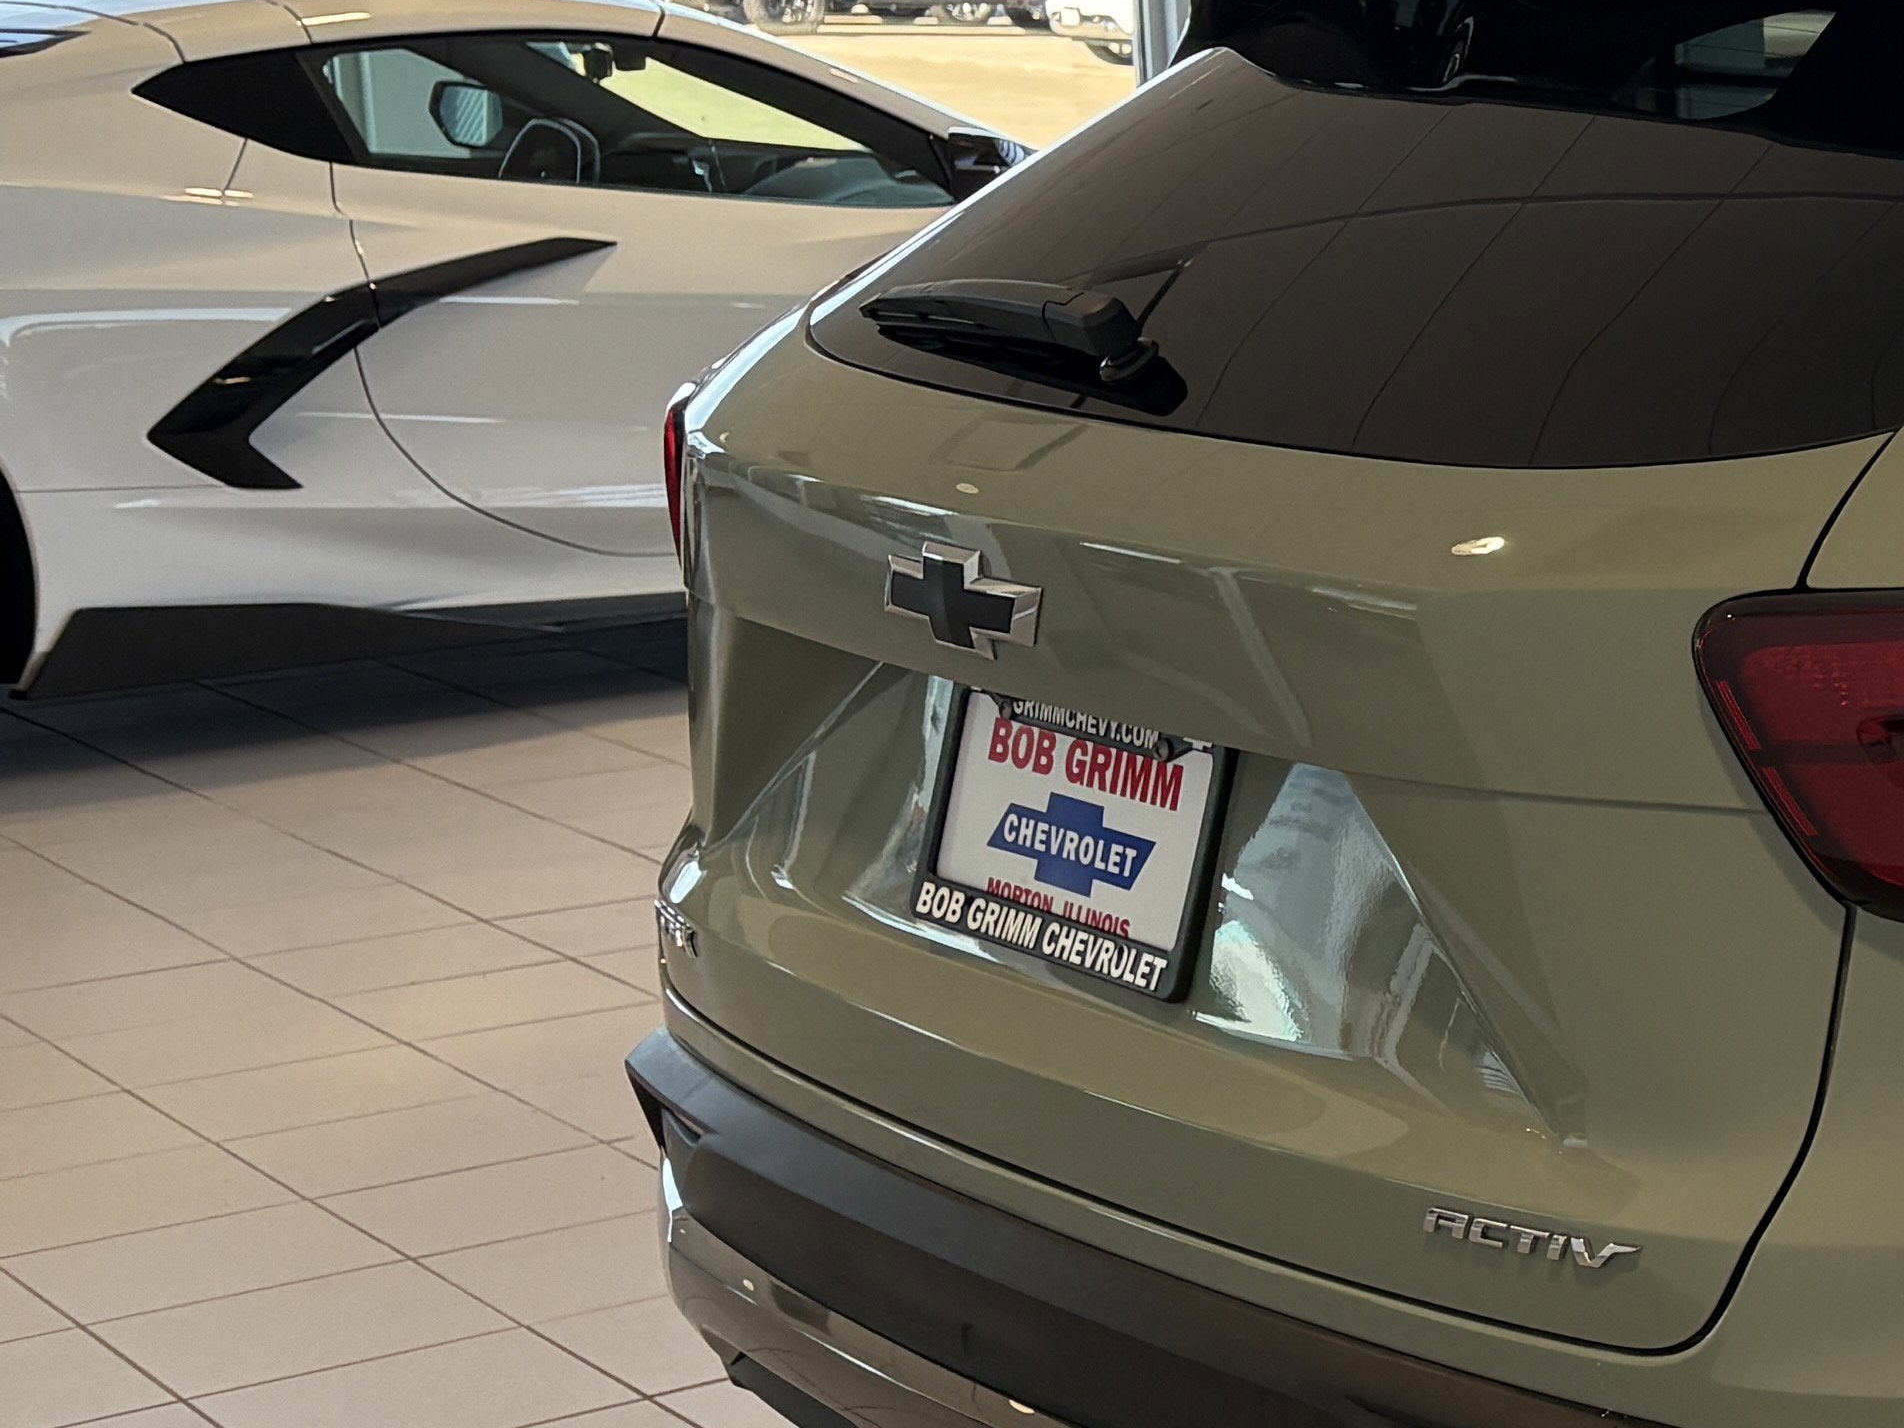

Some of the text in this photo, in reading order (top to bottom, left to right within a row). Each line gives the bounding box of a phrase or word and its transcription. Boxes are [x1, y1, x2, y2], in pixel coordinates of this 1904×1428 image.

[1012, 699, 1160, 750] GRIMMCHEVY.COM
[988, 716, 1184, 812] BOB GRIMM
[1003, 812, 1138, 878] CHEVROLET
[915, 881, 1168, 992] BOB GRIMM CHEVROLET
[986, 876, 1131, 939] MORTON ILLINOIS
[1423, 1206, 1643, 1269] ACTIV
